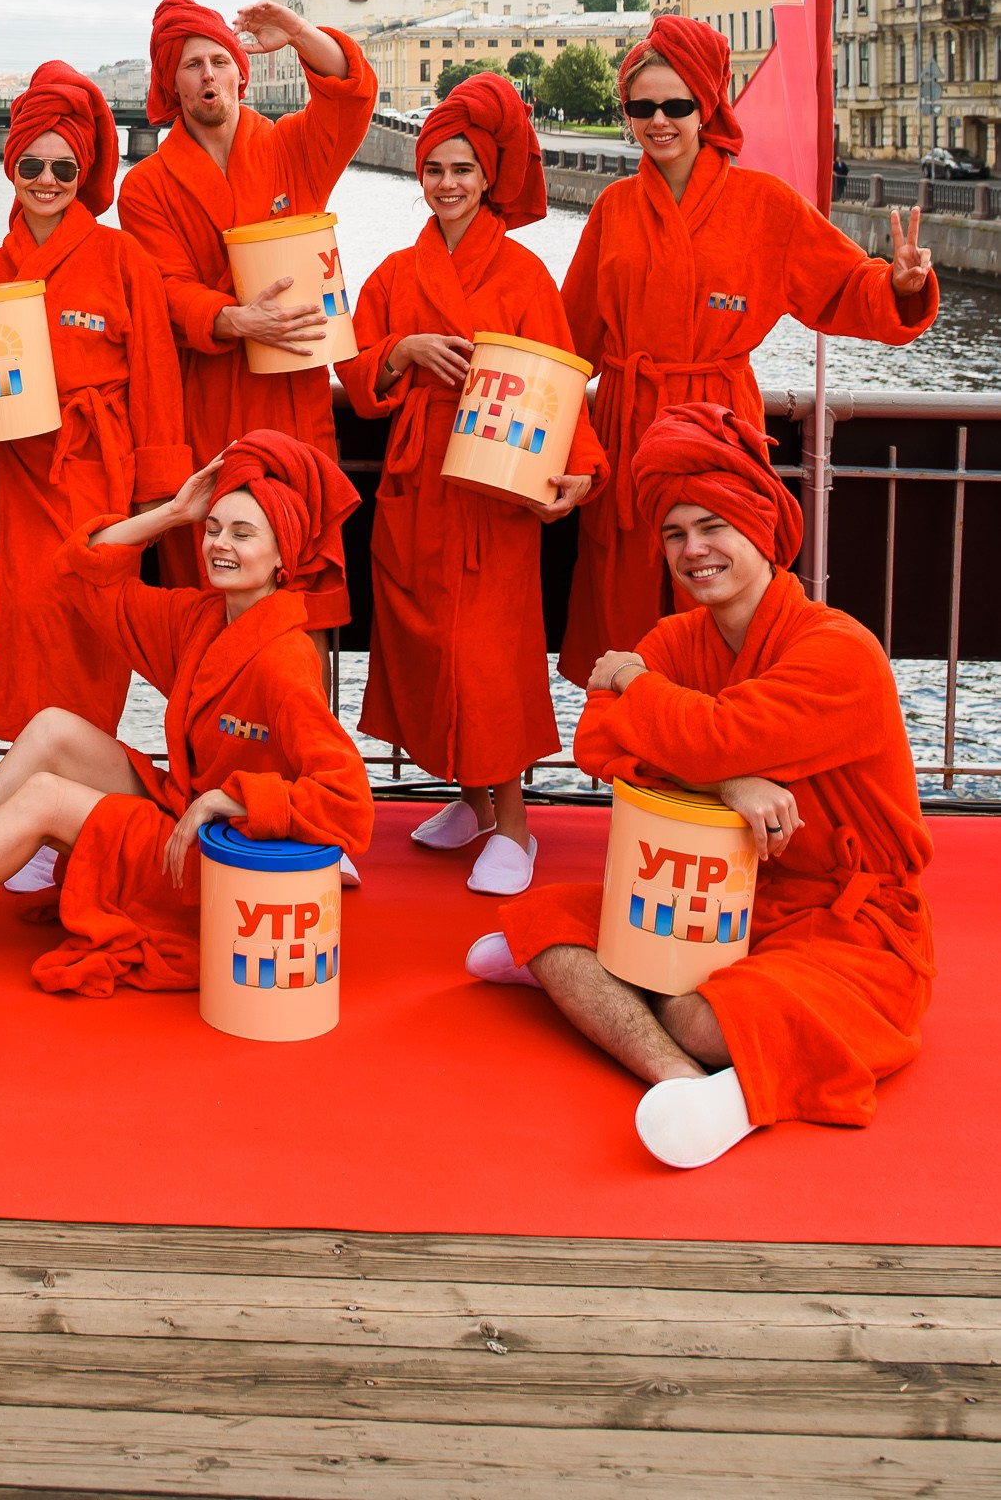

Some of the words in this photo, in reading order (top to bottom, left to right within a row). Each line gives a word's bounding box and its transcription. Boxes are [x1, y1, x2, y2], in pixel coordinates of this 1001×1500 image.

[59, 309, 105, 332] ТНТ
[708, 291, 747, 312] ТНТ
[454, 400, 548, 454] ТНТ
[219, 713, 269, 743] ТНТ
[629, 881, 750, 944] ТНТ
[233, 933, 339, 989] ТНТ
